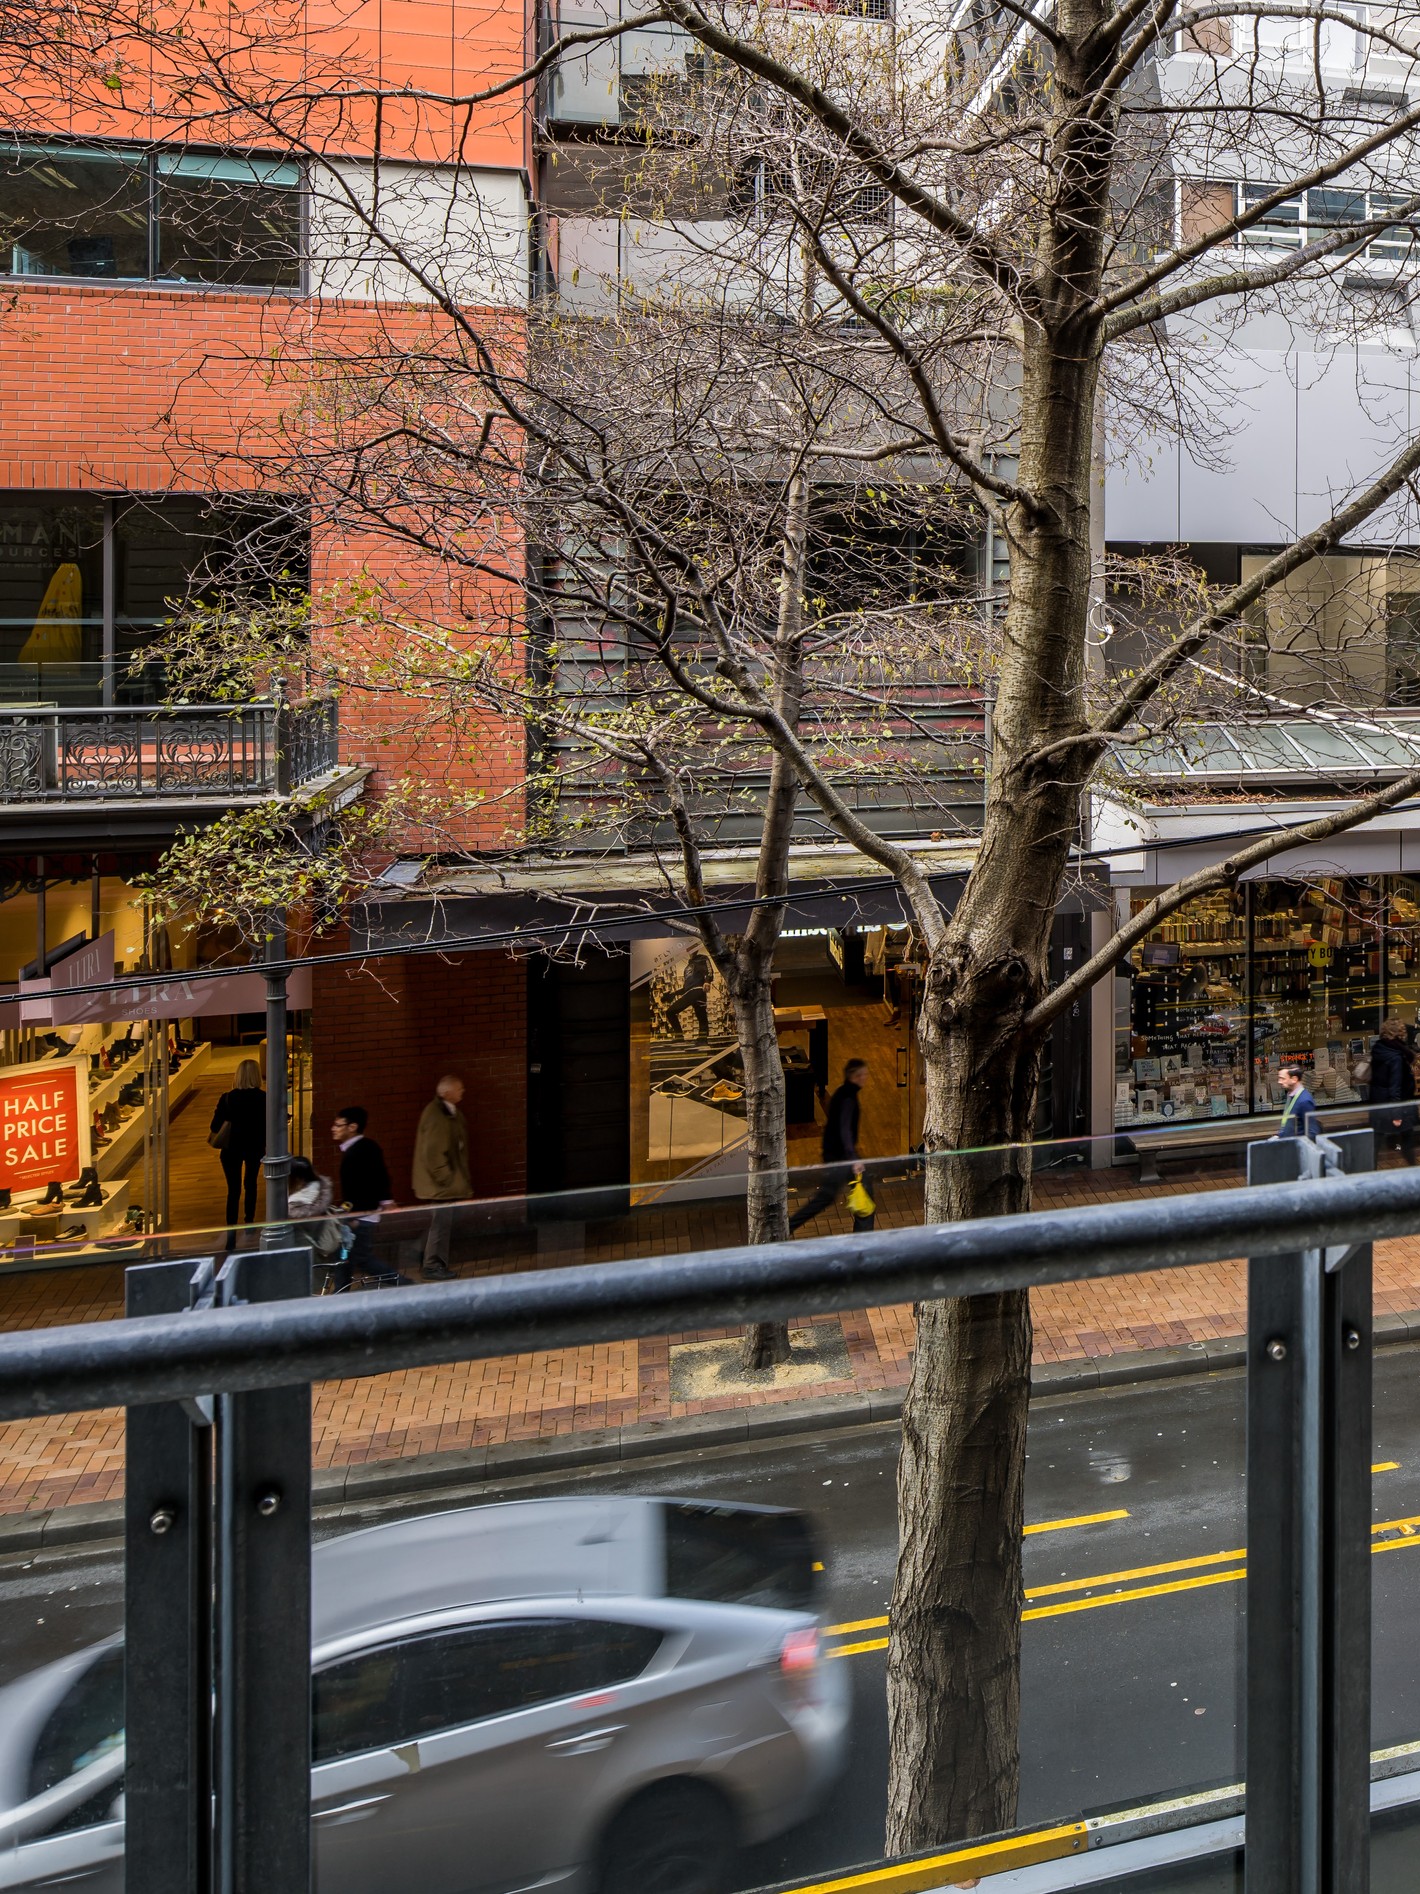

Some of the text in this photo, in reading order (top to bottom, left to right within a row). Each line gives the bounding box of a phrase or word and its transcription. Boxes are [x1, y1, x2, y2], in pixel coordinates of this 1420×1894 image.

[121, 1006, 158, 1017] SHOES
[4, 1090, 64, 1117] HALF
[4, 1113, 67, 1141] PRICE
[5, 1138, 67, 1166] SALE
